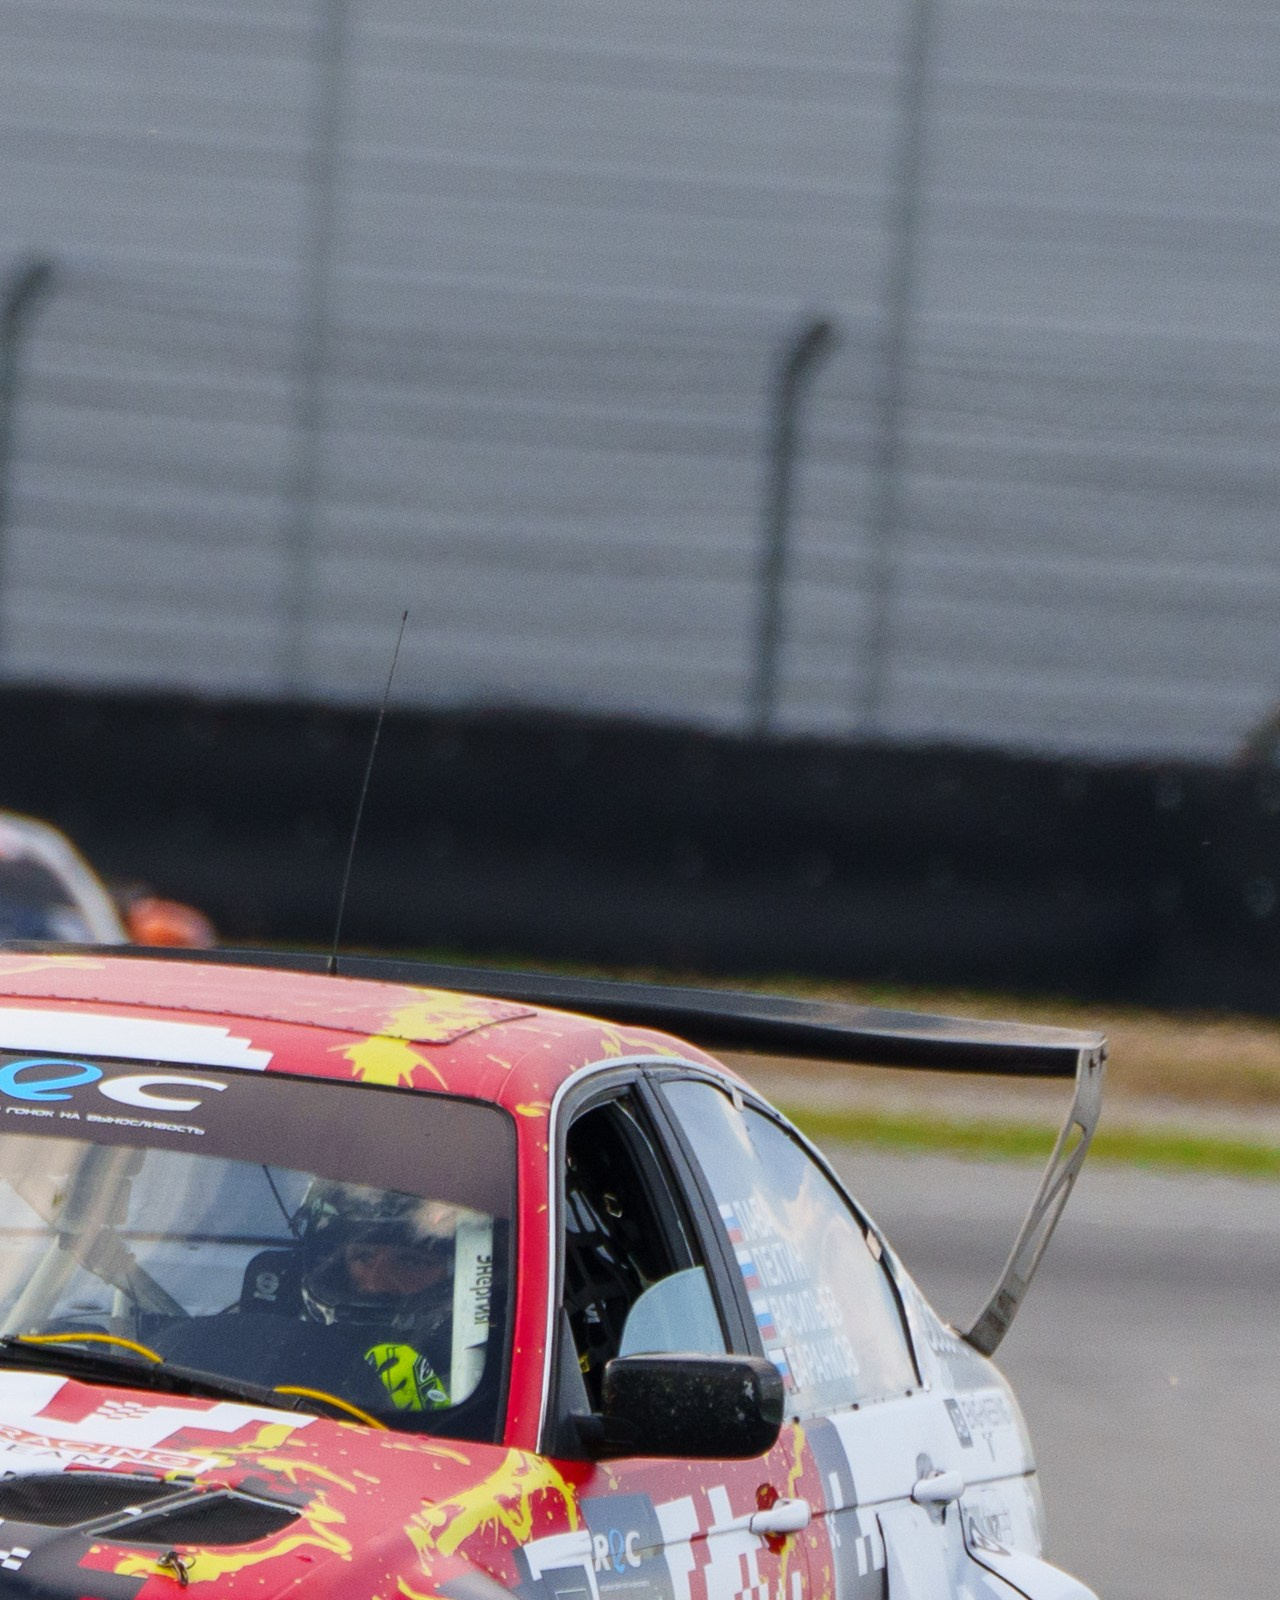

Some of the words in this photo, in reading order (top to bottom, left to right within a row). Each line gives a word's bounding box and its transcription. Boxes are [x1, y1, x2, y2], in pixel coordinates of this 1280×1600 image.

[5, 1107, 55, 1119] ГОНОК
[60, 1111, 81, 1121] НА
[86, 1115, 206, 1136] ВЫНОСЛИВОСТЬ
